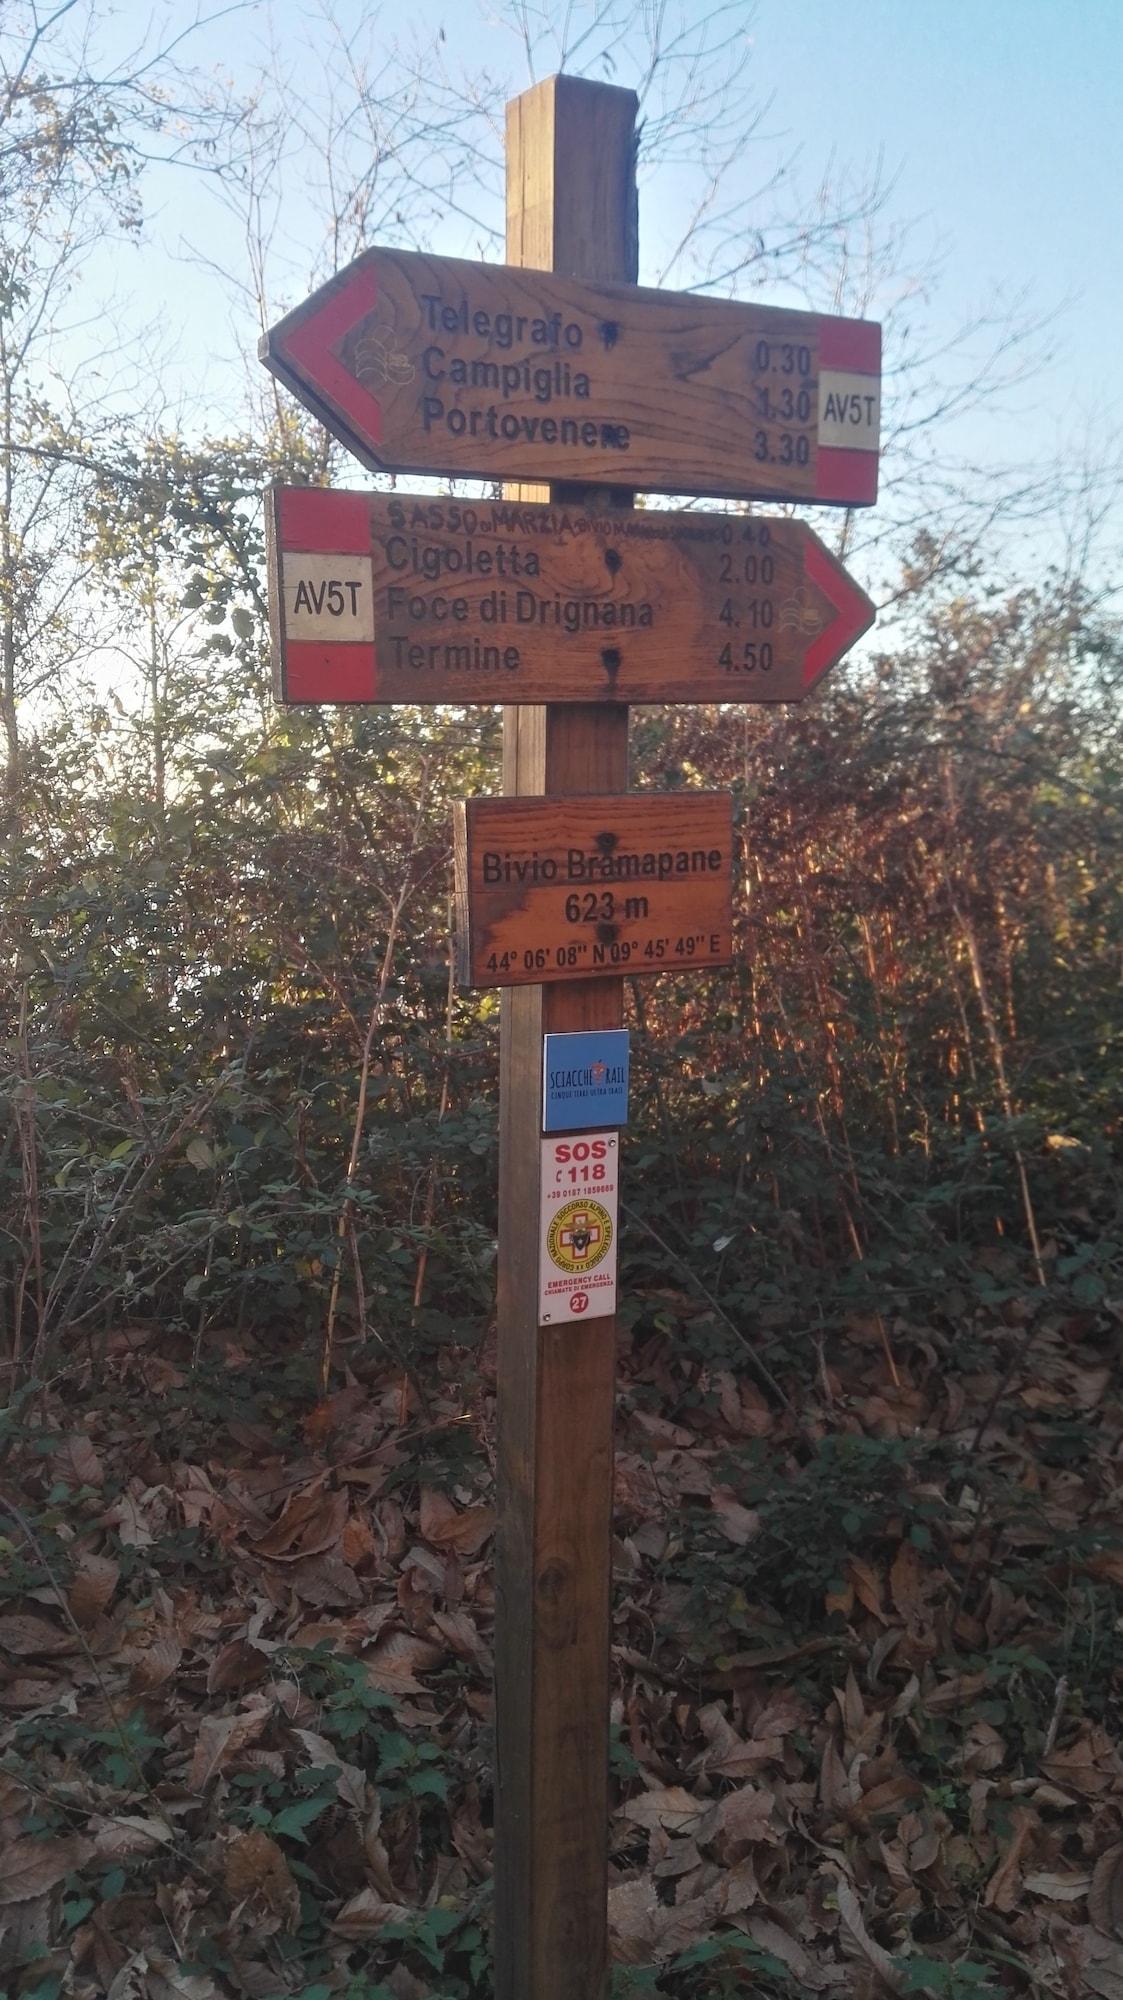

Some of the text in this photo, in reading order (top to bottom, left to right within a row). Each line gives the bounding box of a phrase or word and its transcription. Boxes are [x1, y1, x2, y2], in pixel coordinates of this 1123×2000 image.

[421, 294, 810, 375] Telegrafo 0.30
[423, 346, 810, 422] Campiglia 1.30
[823, 392, 876, 427] AV5T
[423, 397, 810, 465] Portovenere 3.30
[387, 500, 478, 534] SASSO
[386, 536, 774, 586] Cigoletta 2.00
[294, 580, 362, 617] AV5T
[387, 586, 774, 633] Foce di Drignana 4.10
[388, 635, 773, 672] Termine 4.50
[482, 848, 722, 884] Bivio Bramapane
[565, 891, 649, 923] 623 m
[592, 944, 605, 964] N
[710, 934, 721, 953] E
[555, 1140, 607, 1163] SOS
[568, 1164, 606, 1183] 118
[547, 1273, 610, 1289] EMERGENCY CALL
[572, 1296, 587, 1310] 27
